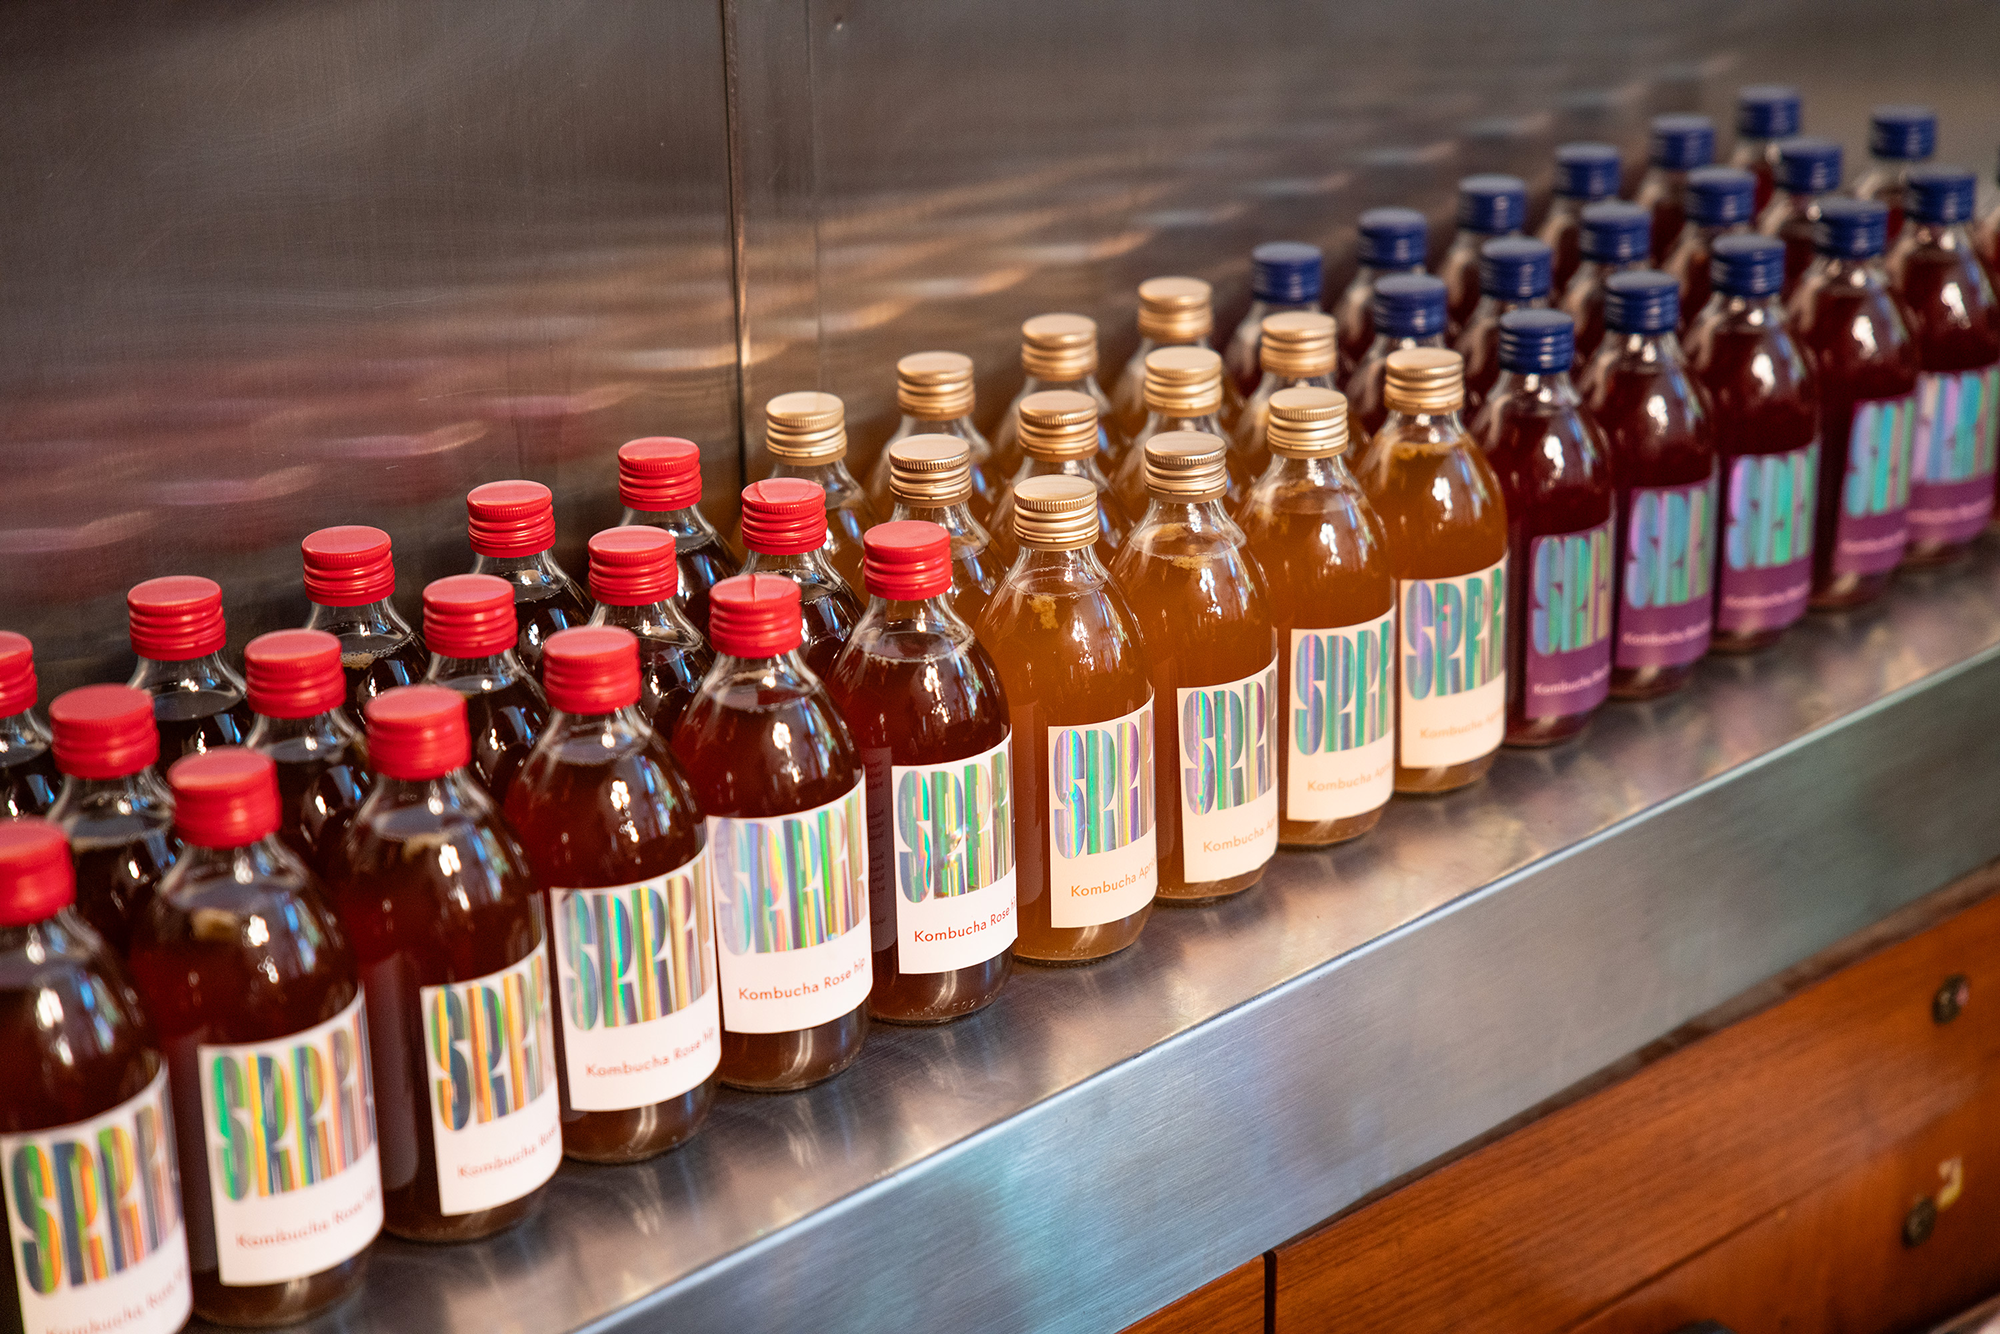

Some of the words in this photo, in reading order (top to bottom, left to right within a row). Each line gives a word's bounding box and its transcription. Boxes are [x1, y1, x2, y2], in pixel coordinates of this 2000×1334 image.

[1307, 774, 1371, 792] Kombucha
[1203, 827, 1264, 853] Kombucha
[1071, 874, 1136, 897] Kombucha
[914, 920, 987, 942] Kombucha
[990, 907, 1010, 926] Rose
[738, 982, 819, 1000] Kombucha
[824, 969, 851, 989] Rose
[585, 1055, 669, 1077] Kombucha
[673, 1046, 700, 1061] Rose
